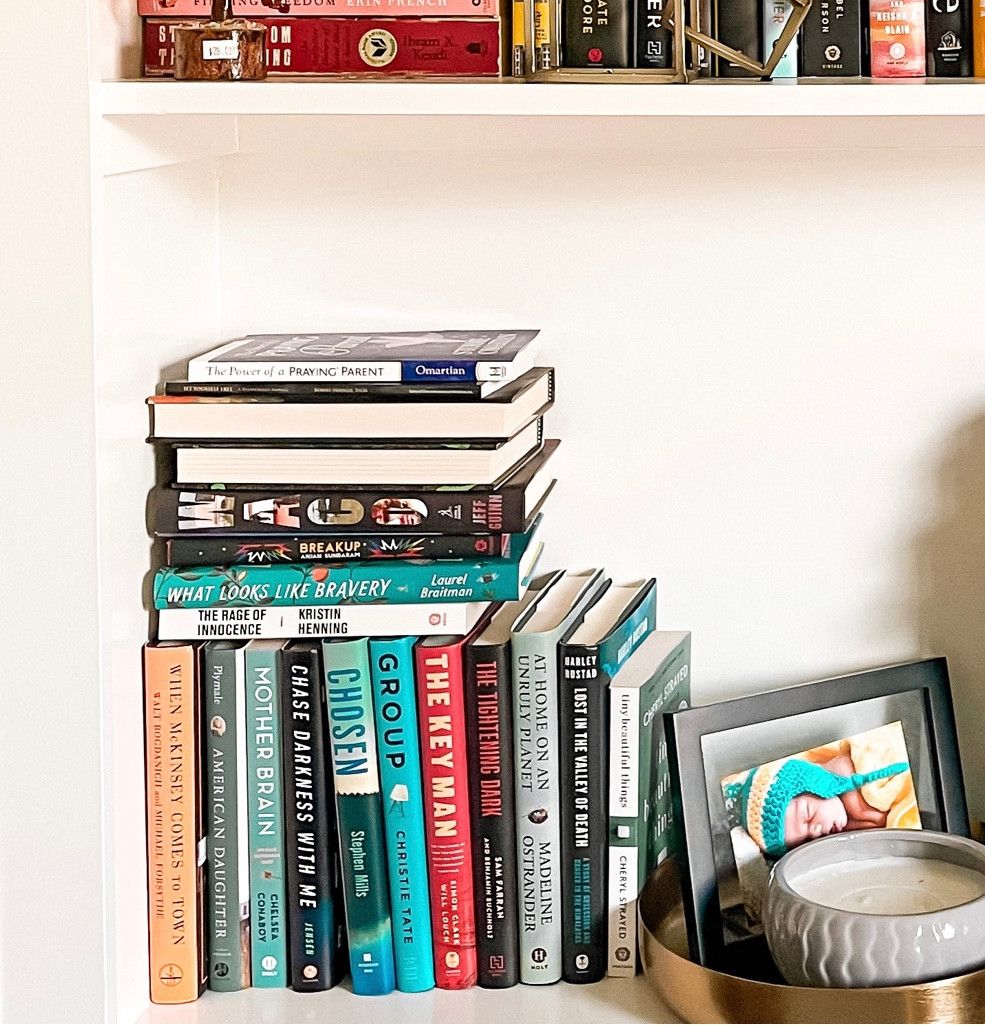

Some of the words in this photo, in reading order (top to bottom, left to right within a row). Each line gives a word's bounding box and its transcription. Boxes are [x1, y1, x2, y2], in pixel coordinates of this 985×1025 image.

[206, 366, 226, 377] The
[229, 366, 256, 378] Power
[260, 365, 274, 377] of
[341, 366, 384, 377] PARENT
[415, 364, 465, 376] Omartian
[300, 542, 361, 554] BREAKUP
[168, 585, 215, 602] WHAT
[220, 584, 268, 600] LOOKS
[275, 582, 310, 599] LIKE
[314, 579, 392, 598] BRAVERY
[420, 585, 473, 598] Braitman
[431, 574, 468, 587] Laurel
[198, 610, 218, 622] THE
[222, 609, 252, 622] RAGE
[256, 609, 266, 621] OF
[298, 608, 341, 620] KRISTIN
[197, 623, 262, 636] INNOCENCE
[298, 623, 348, 634] HENNING
[425, 654, 448, 706] THE
[254, 668, 274, 759] MOTHER
[328, 669, 368, 777] CHOSEN
[379, 653, 406, 770] GROUP
[430, 717, 453, 769] KEY
[258, 769, 275, 836] BRAIN
[431, 779, 456, 837] MAN
[522, 835, 536, 932] OSTRANDER
[538, 841, 554, 925] MADELINE
